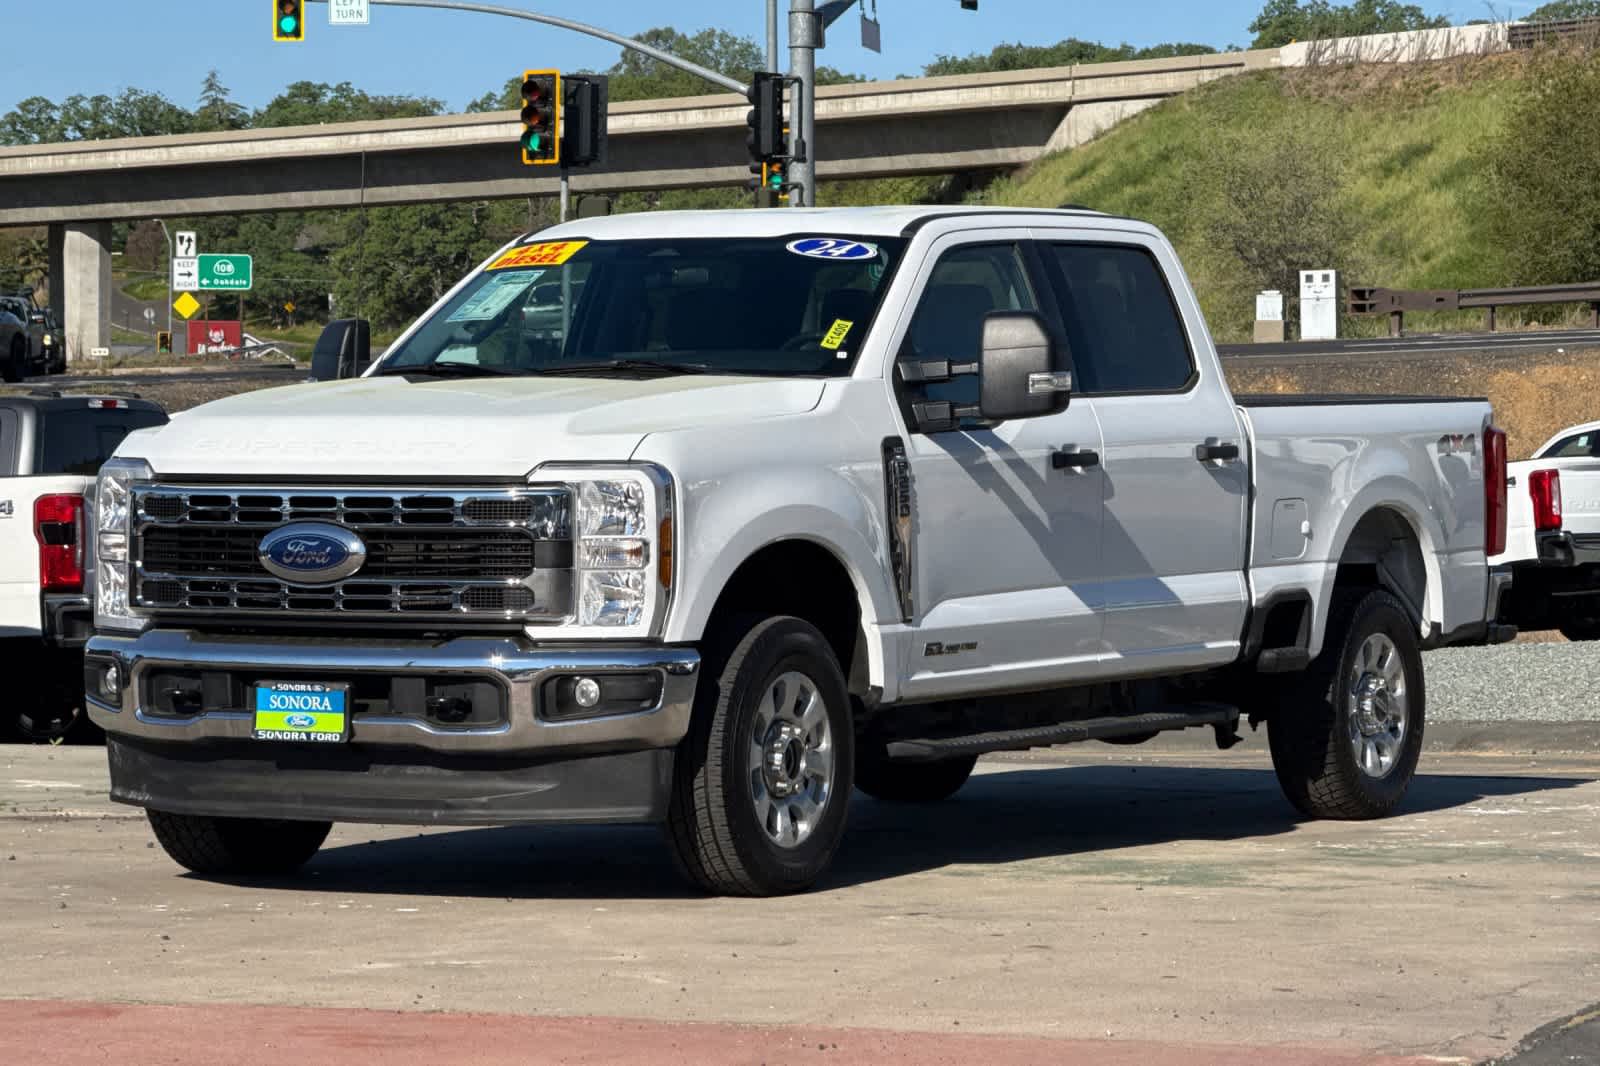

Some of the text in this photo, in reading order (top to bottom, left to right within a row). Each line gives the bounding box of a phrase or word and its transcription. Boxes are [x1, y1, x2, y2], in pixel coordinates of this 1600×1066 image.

[336, 9, 363, 18] TURN
[803, 240, 860, 257] 24
[494, 252, 562, 268] DIESEL
[216, 263, 233, 273] 108
[176, 280, 197, 288] RIGHT
[213, 278, 247, 286] Oakdale
[192, 439, 346, 458] SUPER
[282, 539, 332, 564] Ford
[276, 683, 312, 692] SONORA
[269, 694, 333, 712] SONORA
[257, 731, 341, 742] SONORA FORD
